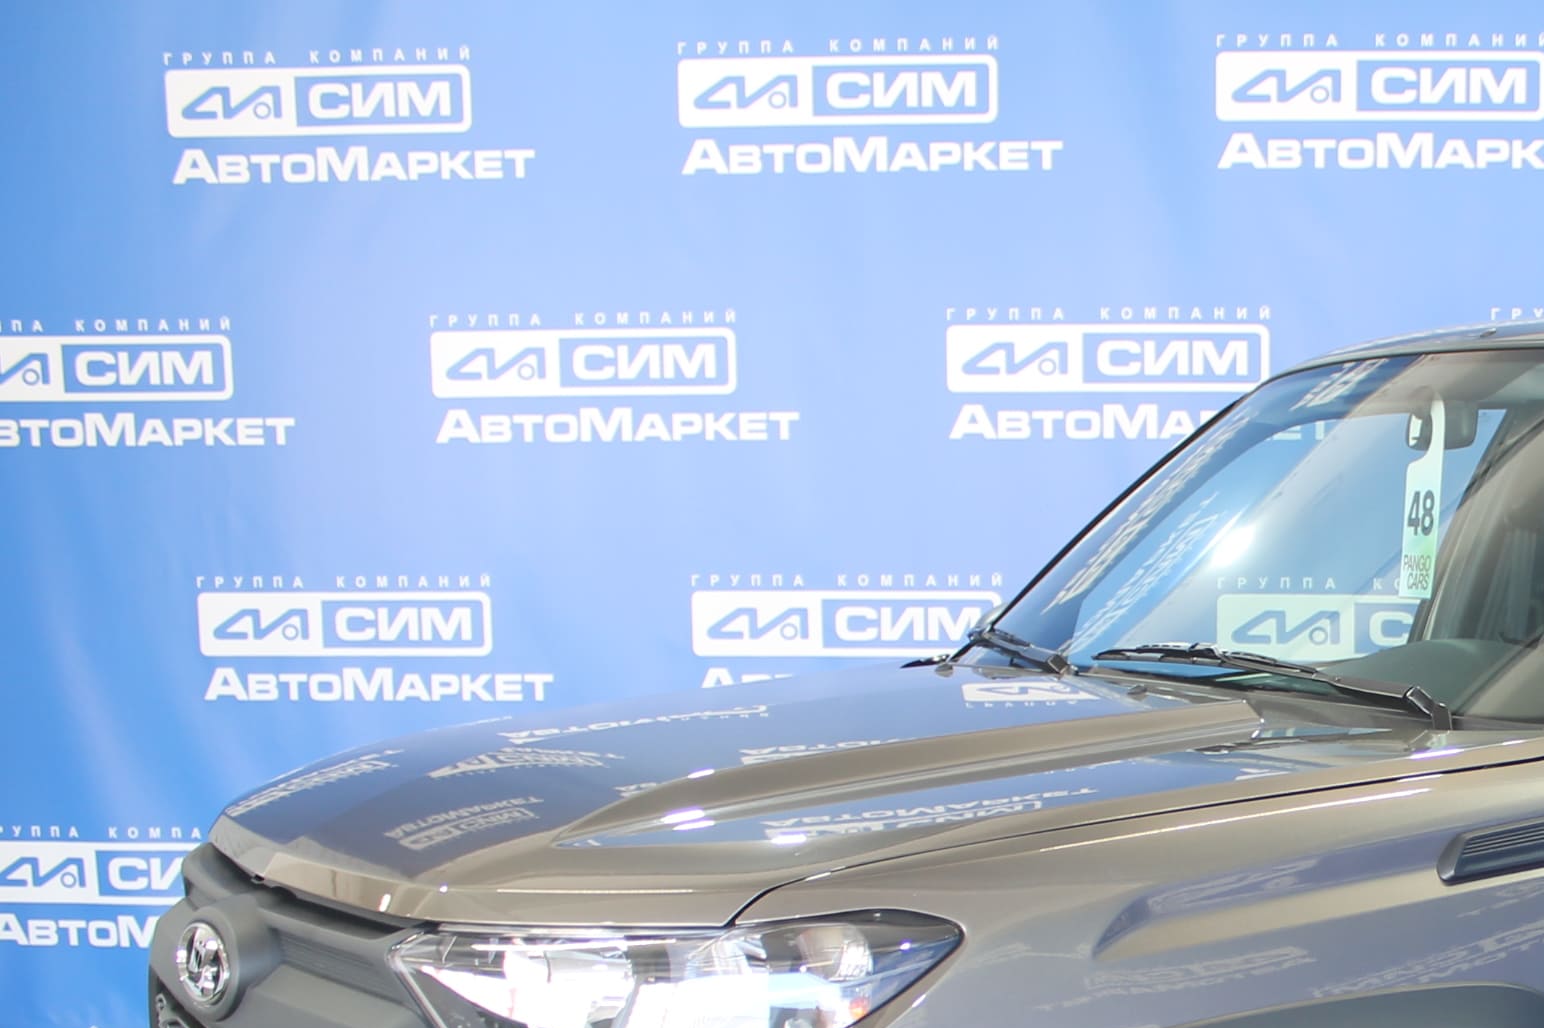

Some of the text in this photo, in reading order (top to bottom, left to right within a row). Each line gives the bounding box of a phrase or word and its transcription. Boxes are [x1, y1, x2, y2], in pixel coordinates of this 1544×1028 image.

[677, 35, 999, 54] ГРУППА КОМПАНИЙ
[1216, 34, 1339, 48] ГРУППА
[164, 45, 470, 66] ГРУППА КОМПАНИЙ
[826, 70, 978, 109] СИМ
[1370, 67, 1527, 105] СИМ
[308, 80, 450, 119] СИМ
[430, 309, 737, 328] ГРУППА КОМПАНИЙ
[947, 305, 1271, 322] ГРУППА КОМПАНИЙ
[76, 316, 231, 332] КОМПАНИЙ
[75, 350, 214, 386] СИМ
[571, 344, 716, 380] СИМ
[1096, 340, 1248, 376] СИМ
[1407, 490, 1434, 536] 48
[1403, 555, 1431, 572] PANGO
[197, 575, 491, 589] ГРУППА КОМПАНИЙ
[692, 574, 1003, 587] ГРУППА КОМПАНИЙ
[1217, 576, 1337, 590] ГРУППА
[1407, 574, 1429, 590] CARS
[334, 606, 473, 641] СИМ
[834, 605, 980, 641] СИМ
